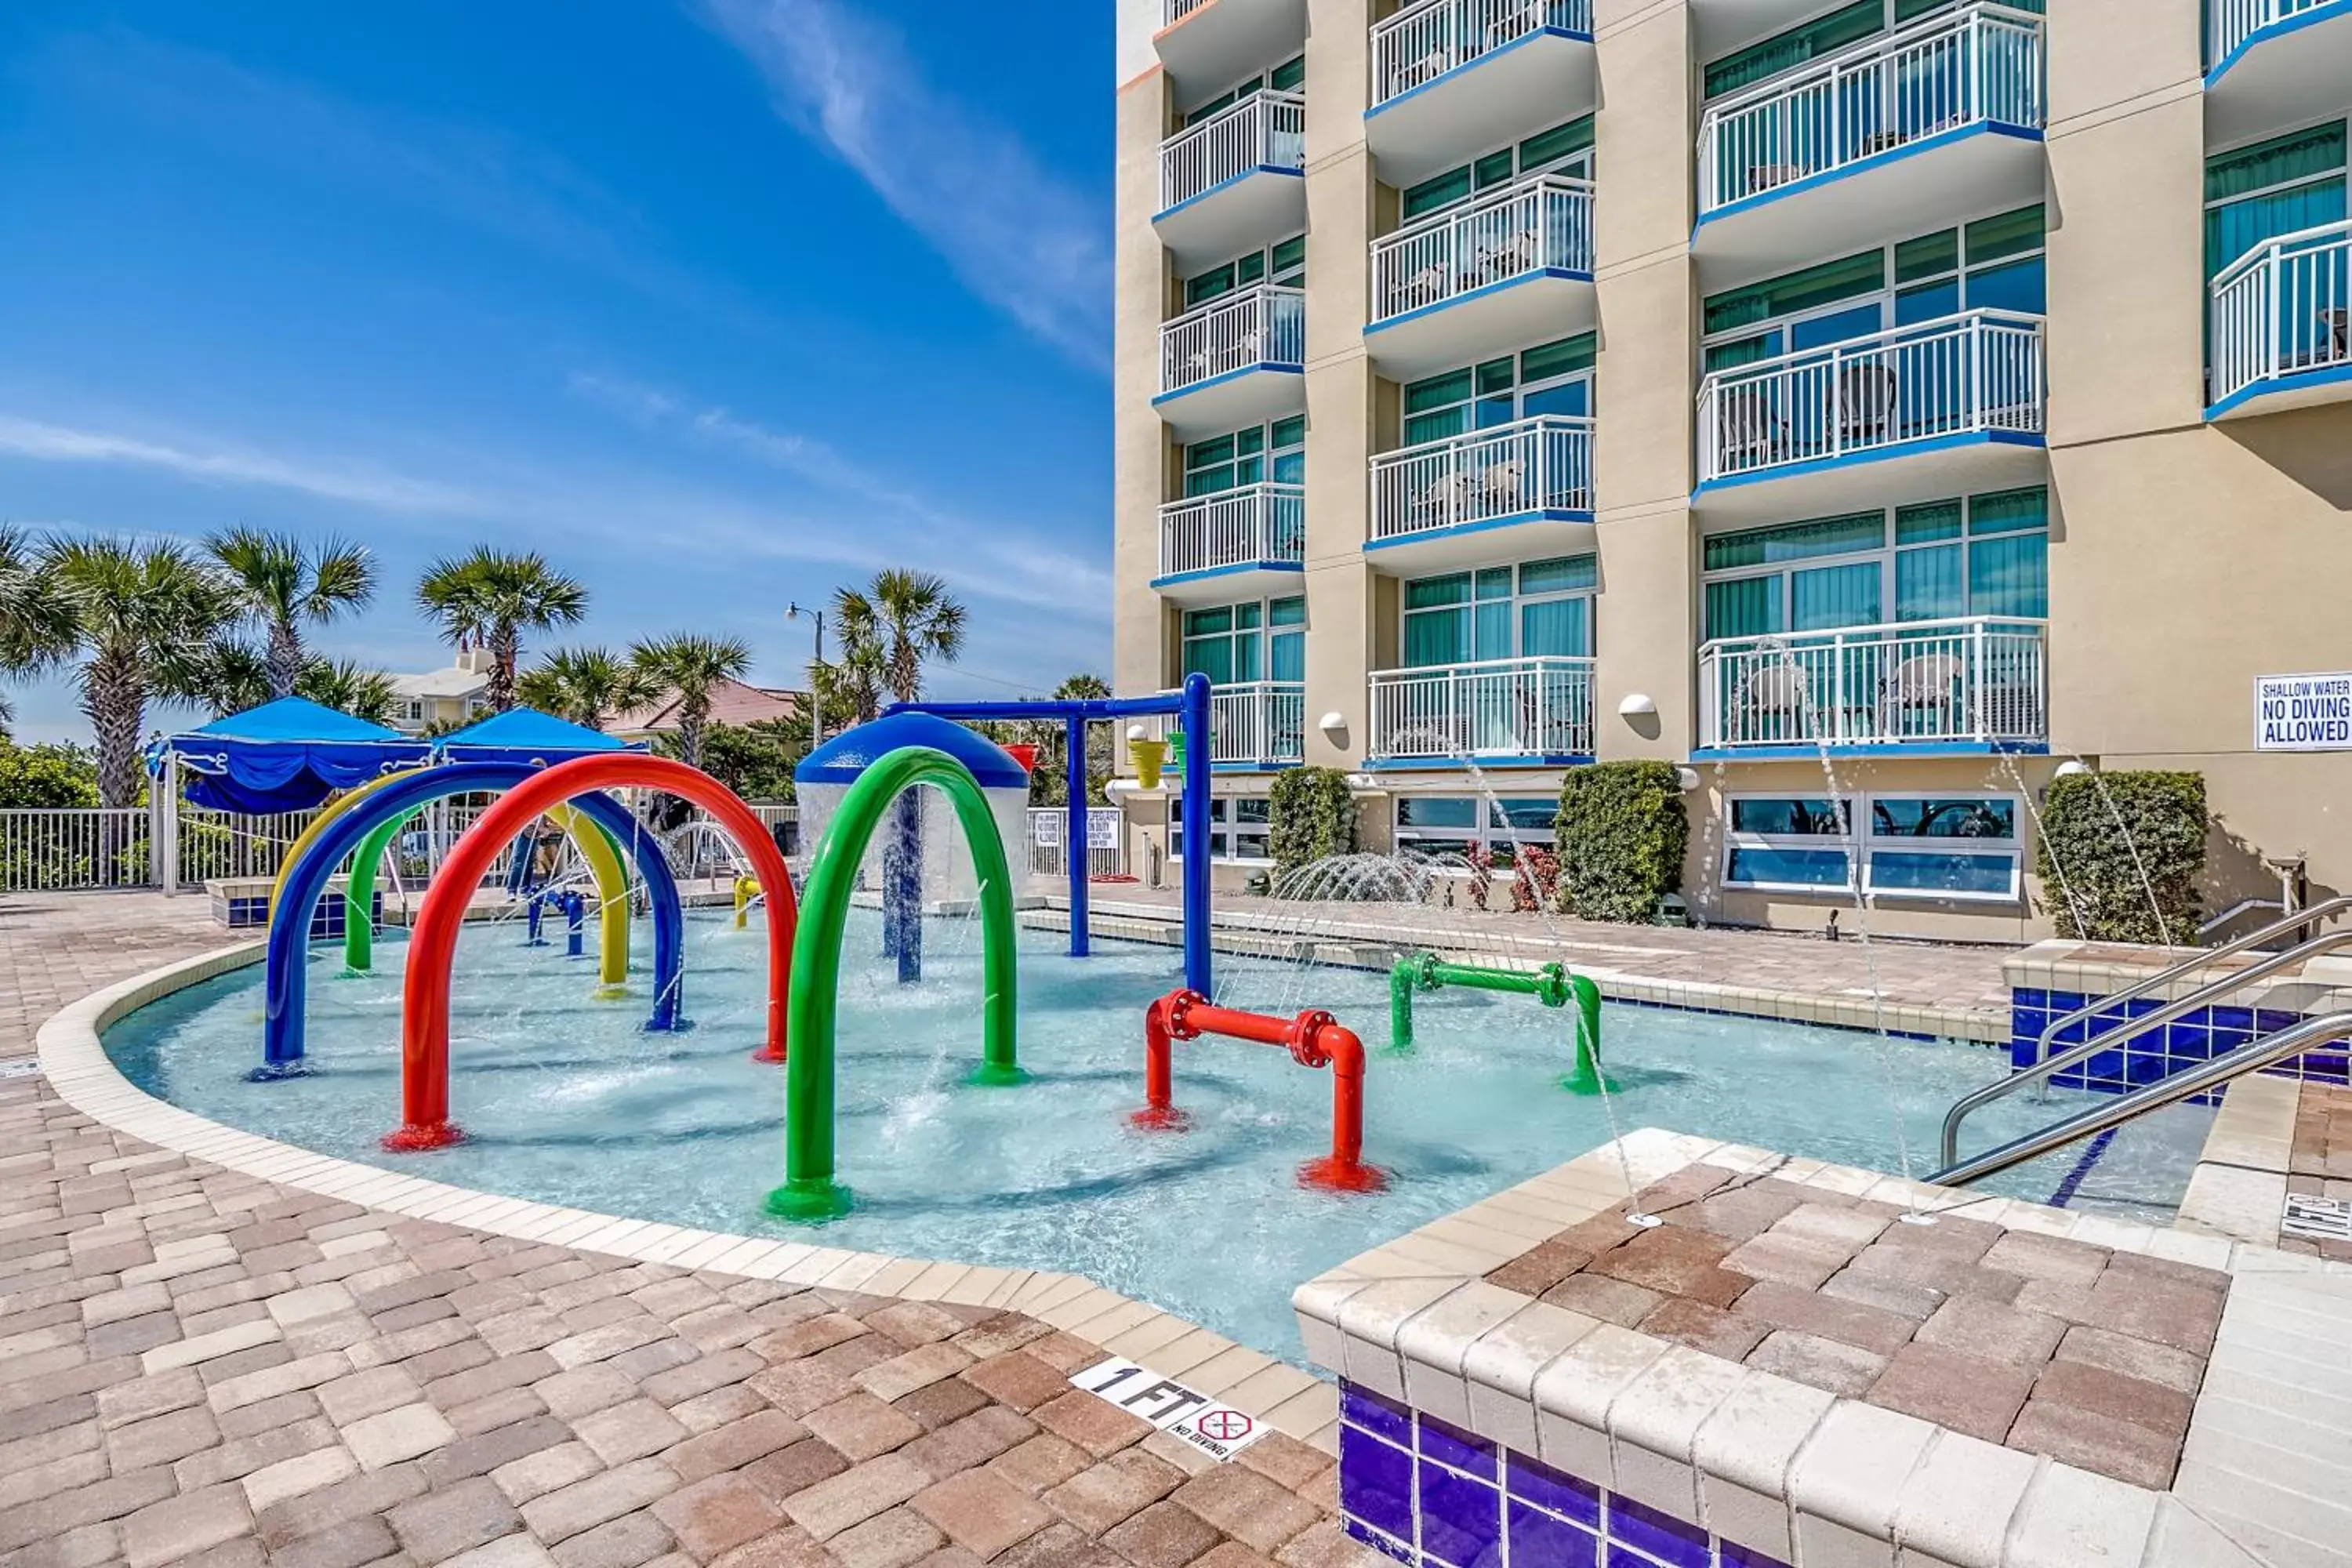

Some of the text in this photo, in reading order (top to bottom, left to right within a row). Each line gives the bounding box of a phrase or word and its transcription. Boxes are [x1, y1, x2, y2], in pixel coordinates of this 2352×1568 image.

[2263, 680, 2350, 698] SHALLOW WATER
[2263, 697, 2350, 720] NO DIVING
[2265, 720, 2349, 742] ALLOWED
[1091, 1367, 1207, 1421] 1 FT
[1172, 1424, 1229, 1457] NO DIVING
